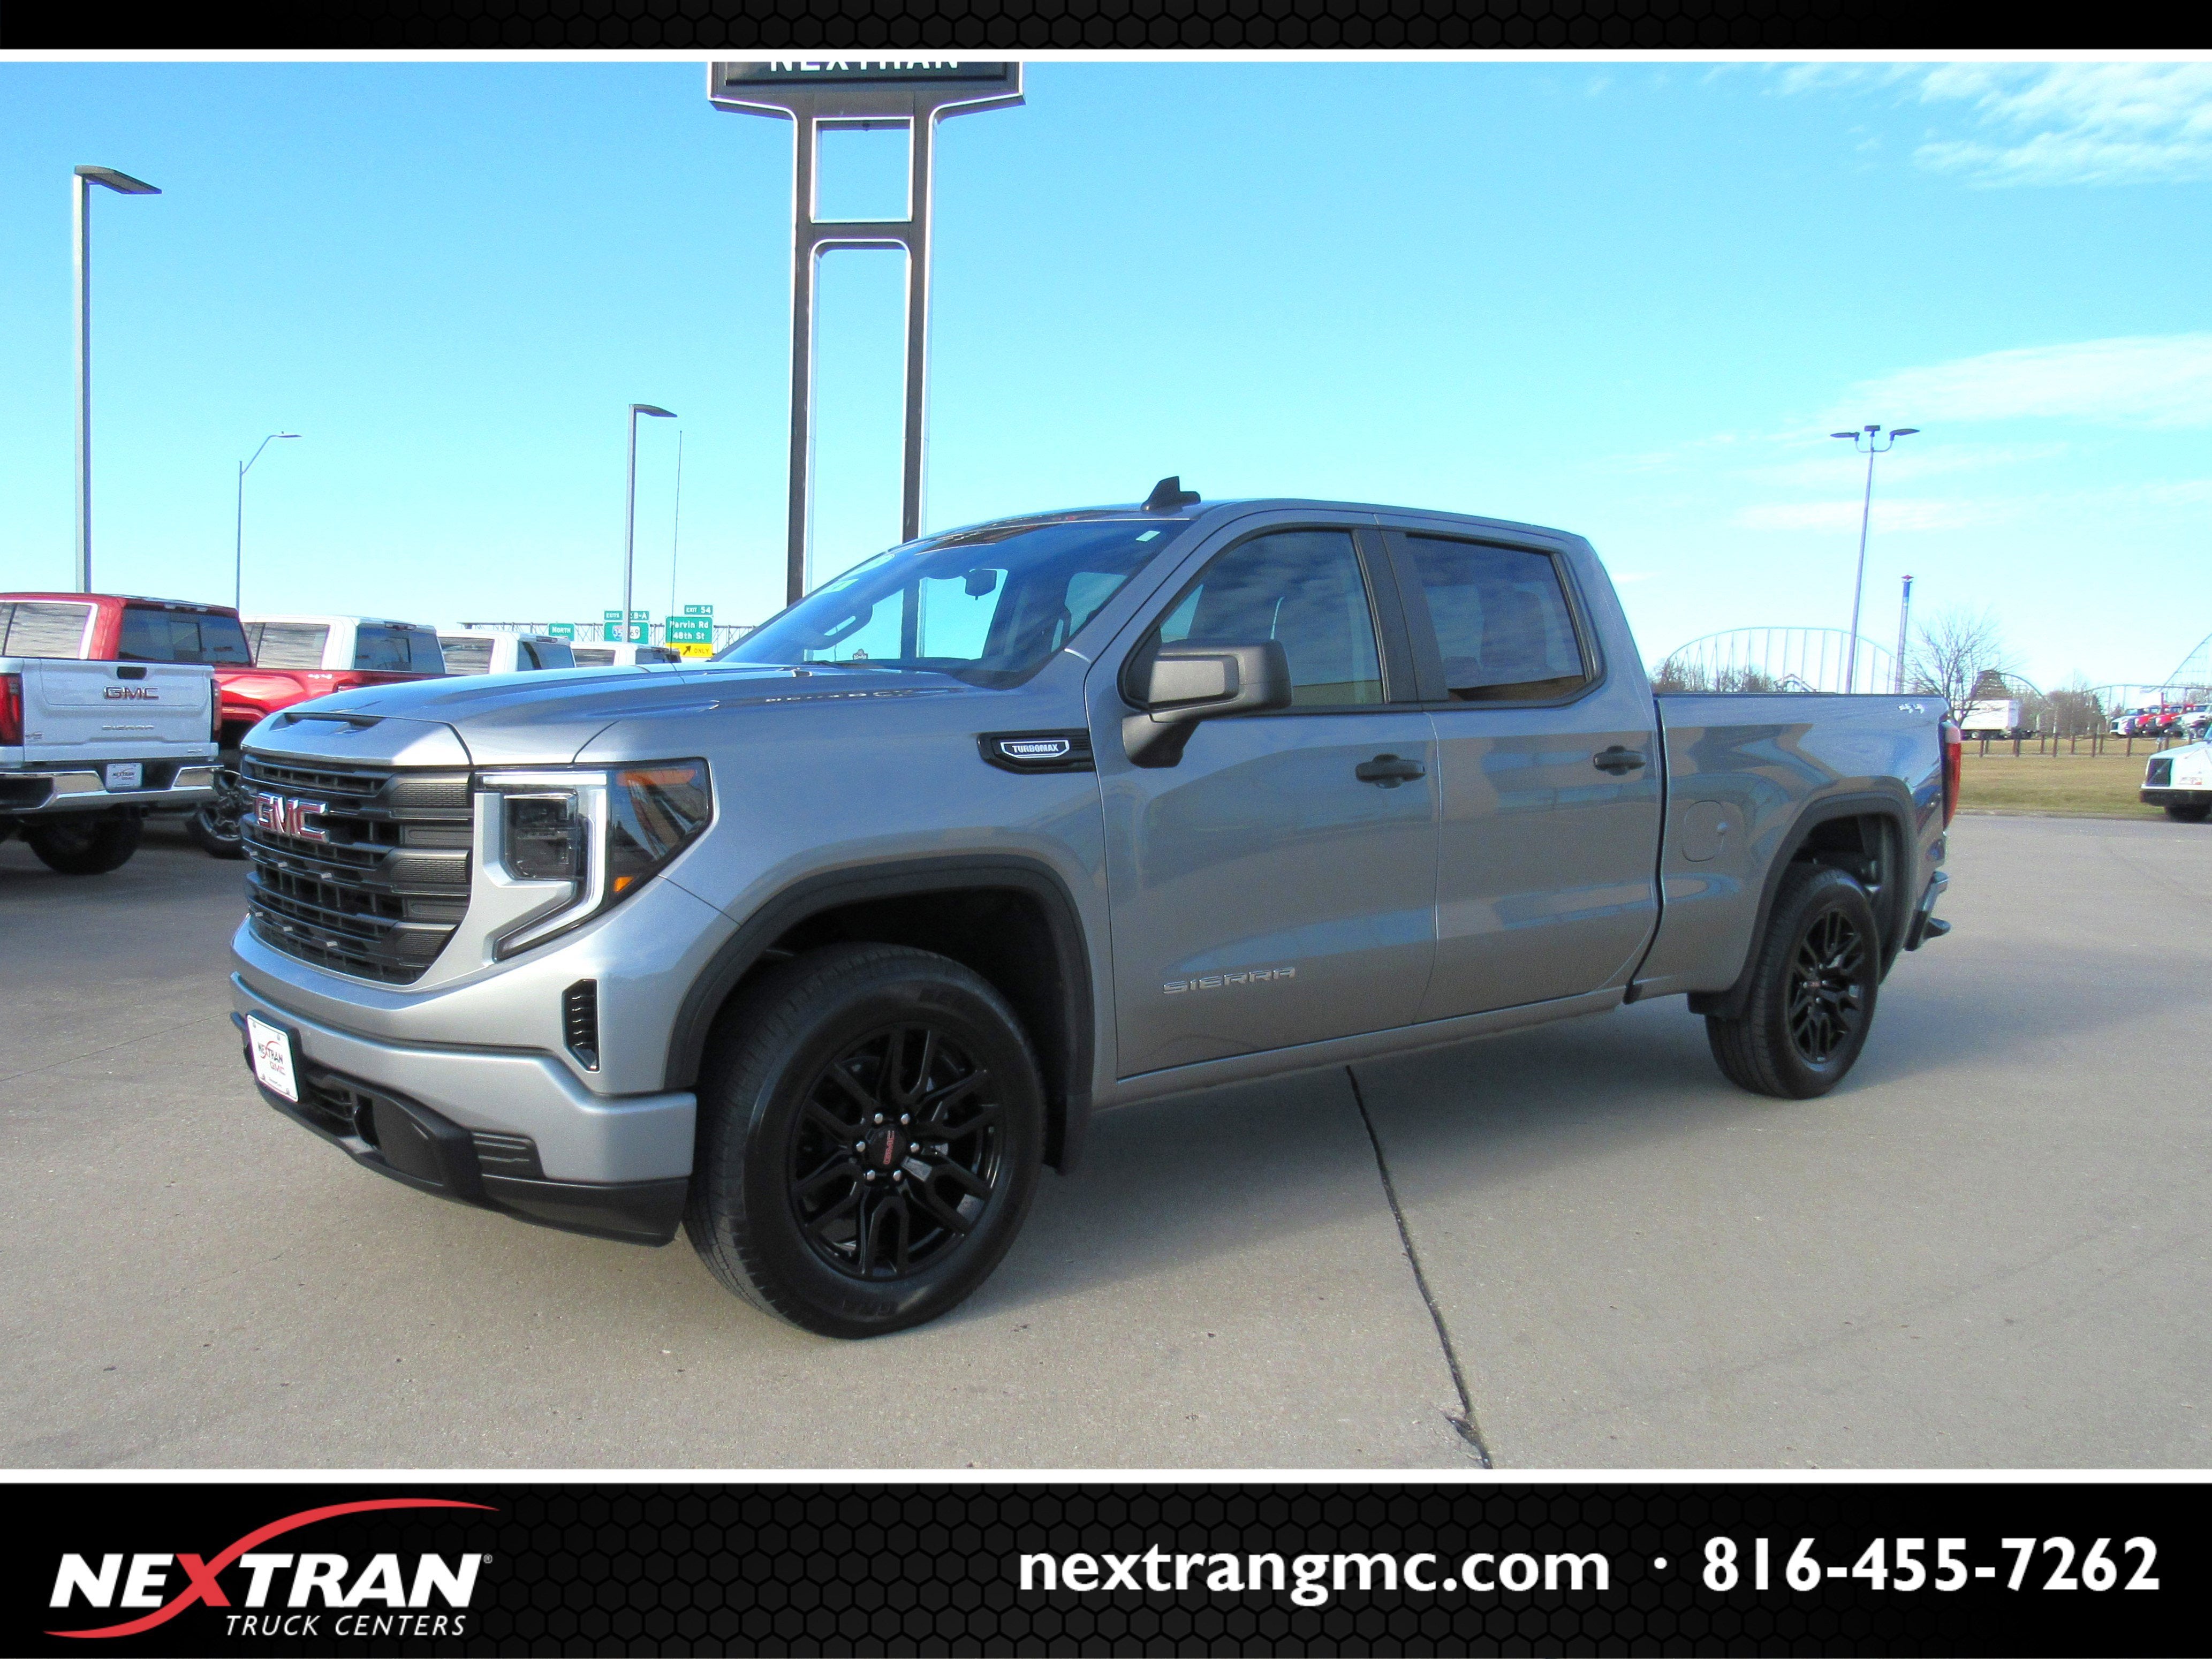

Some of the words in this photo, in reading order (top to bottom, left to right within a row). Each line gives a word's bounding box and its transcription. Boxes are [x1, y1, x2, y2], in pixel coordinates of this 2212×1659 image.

[669, 620, 695, 628] Parvin
[699, 620, 709, 628] Rd
[696, 632, 704, 640] St
[104, 686, 159, 700] GMC
[1012, 744, 1058, 753] TURBOMAX
[255, 792, 330, 843] GMC
[1163, 967, 1296, 994] SIERRA
[257, 1041, 284, 1064] NEXTRAN
[269, 1061, 286, 1075] GMC
[882, 1130, 895, 1165] GMC
